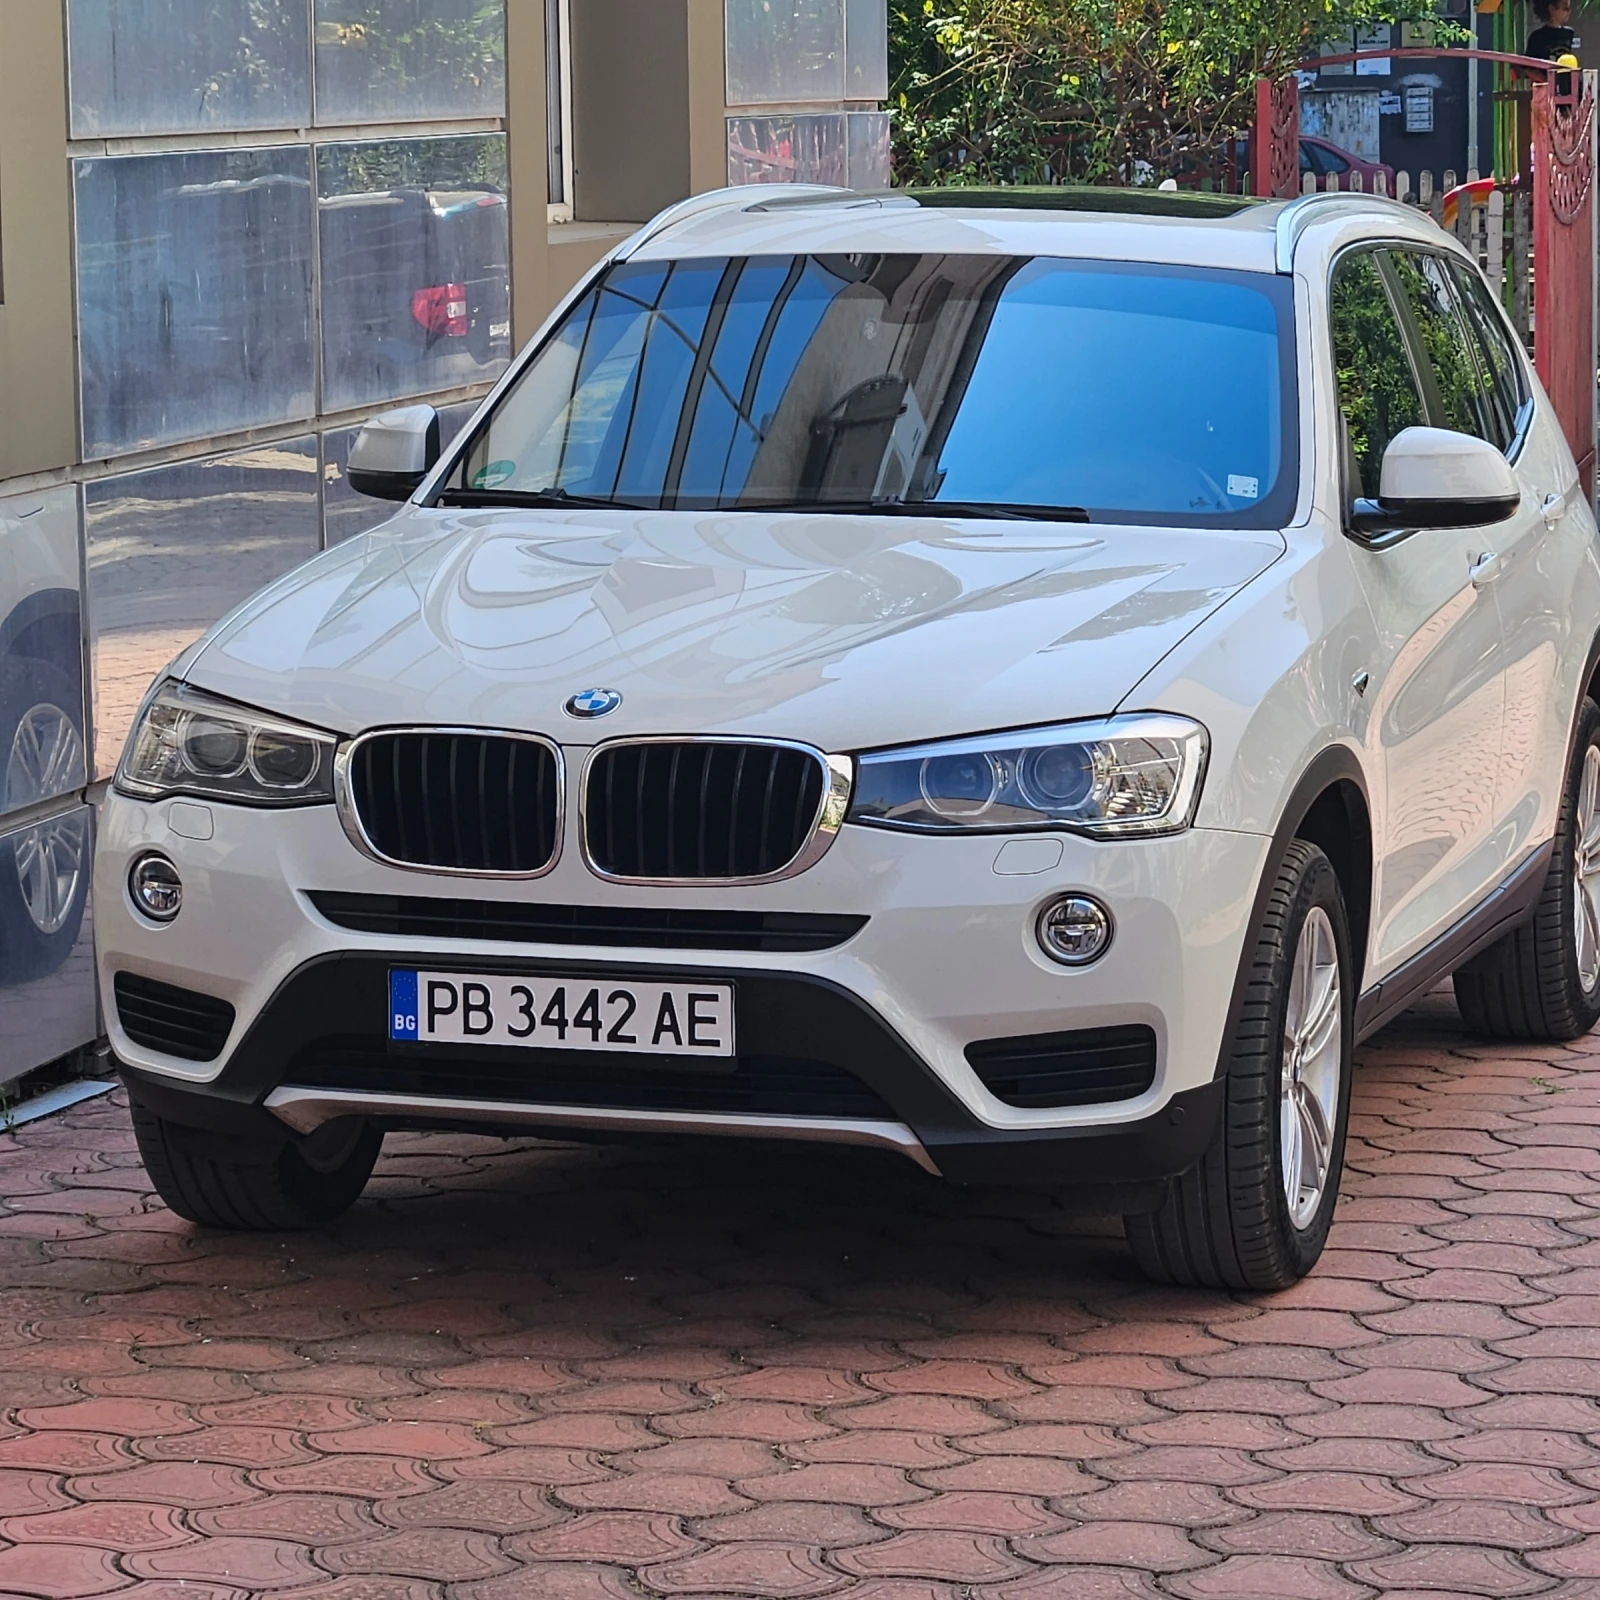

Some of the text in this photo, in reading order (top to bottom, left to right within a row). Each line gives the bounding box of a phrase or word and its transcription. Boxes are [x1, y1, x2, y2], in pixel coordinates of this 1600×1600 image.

[394, 1014, 416, 1031] BG
[427, 980, 721, 1047] PB 3442 AE
